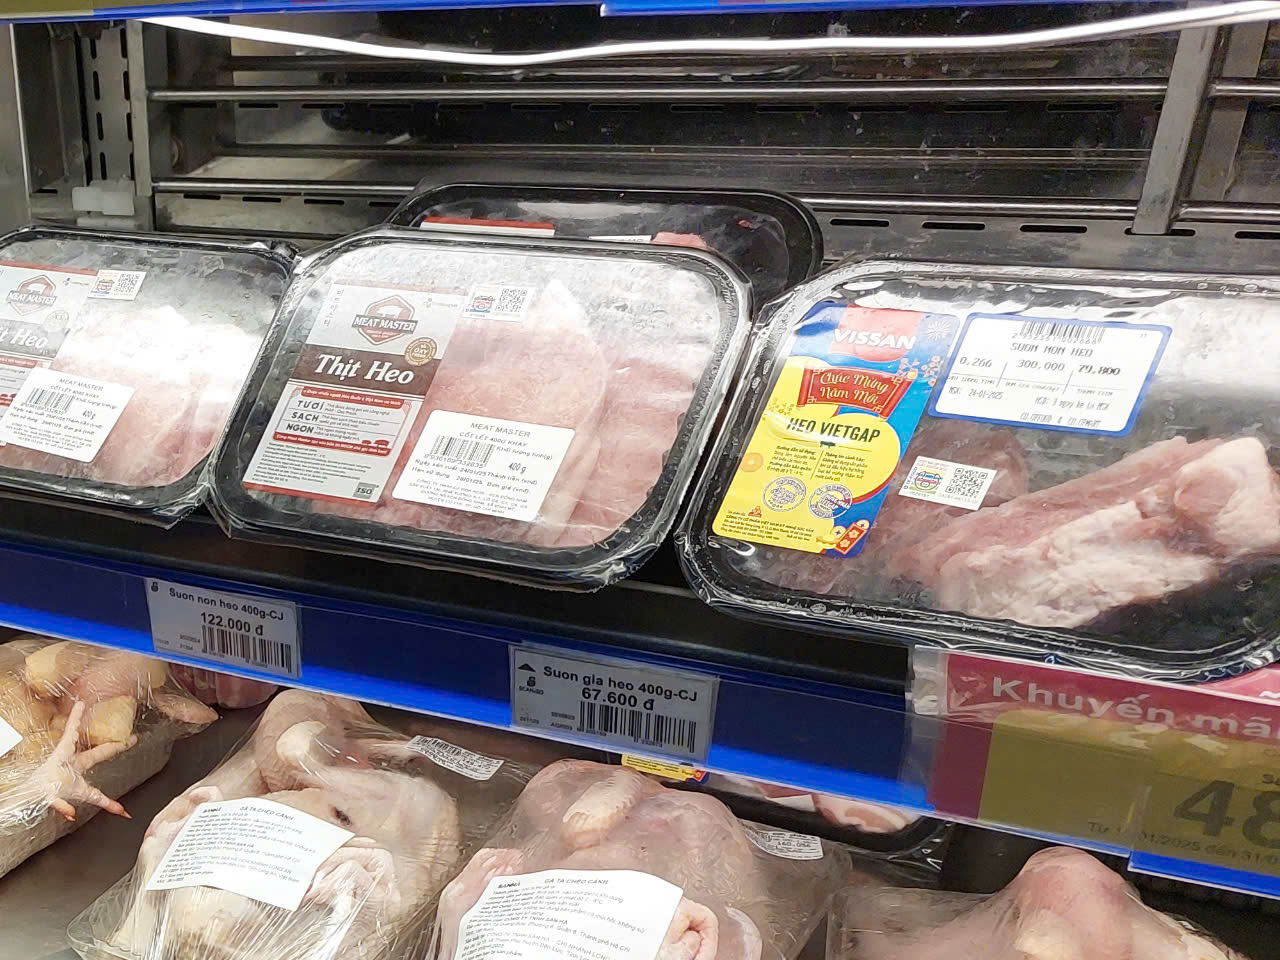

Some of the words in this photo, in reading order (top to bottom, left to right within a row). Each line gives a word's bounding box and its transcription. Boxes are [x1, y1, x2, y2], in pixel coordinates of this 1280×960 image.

[354, 316, 378, 327] MEAT
[379, 319, 416, 331] MASTER
[10, 329, 49, 350] Heo
[833, 328, 917, 350] VISSAN
[315, 354, 362, 381] Thịt
[364, 360, 415, 385] Heo
[959, 356, 993, 369] 0.266
[1016, 359, 1065, 372] 300.000
[1078, 364, 1121, 376] 79.800
[820, 371, 851, 385] Chúc
[853, 373, 890, 394] Mừng
[820, 386, 850, 400] Năm
[297, 400, 325, 411] TƯƠI
[291, 411, 320, 423] SẠCH
[286, 423, 315, 434] NGON
[470, 422, 496, 433] MEAT
[496, 426, 531, 438] MASTER
[786, 417, 816, 434] HEO
[819, 421, 882, 443] VIETGAP
[169, 587, 195, 603] Suon
[197, 595, 217, 607] non
[219, 598, 239, 612] heo
[241, 604, 284, 621] 400g-CJ
[200, 611, 252, 634] 122.000
[255, 624, 264, 636] đ
[543, 665, 579, 684] Suon
[582, 673, 604, 687] gia
[608, 676, 634, 692] heo
[637, 682, 698, 703] 400g-CJ
[581, 687, 638, 709] 67.600
[642, 697, 655, 711] đ
[991, 675, 1176, 730] Khuyến
[1190, 712, 1280, 741] mã
